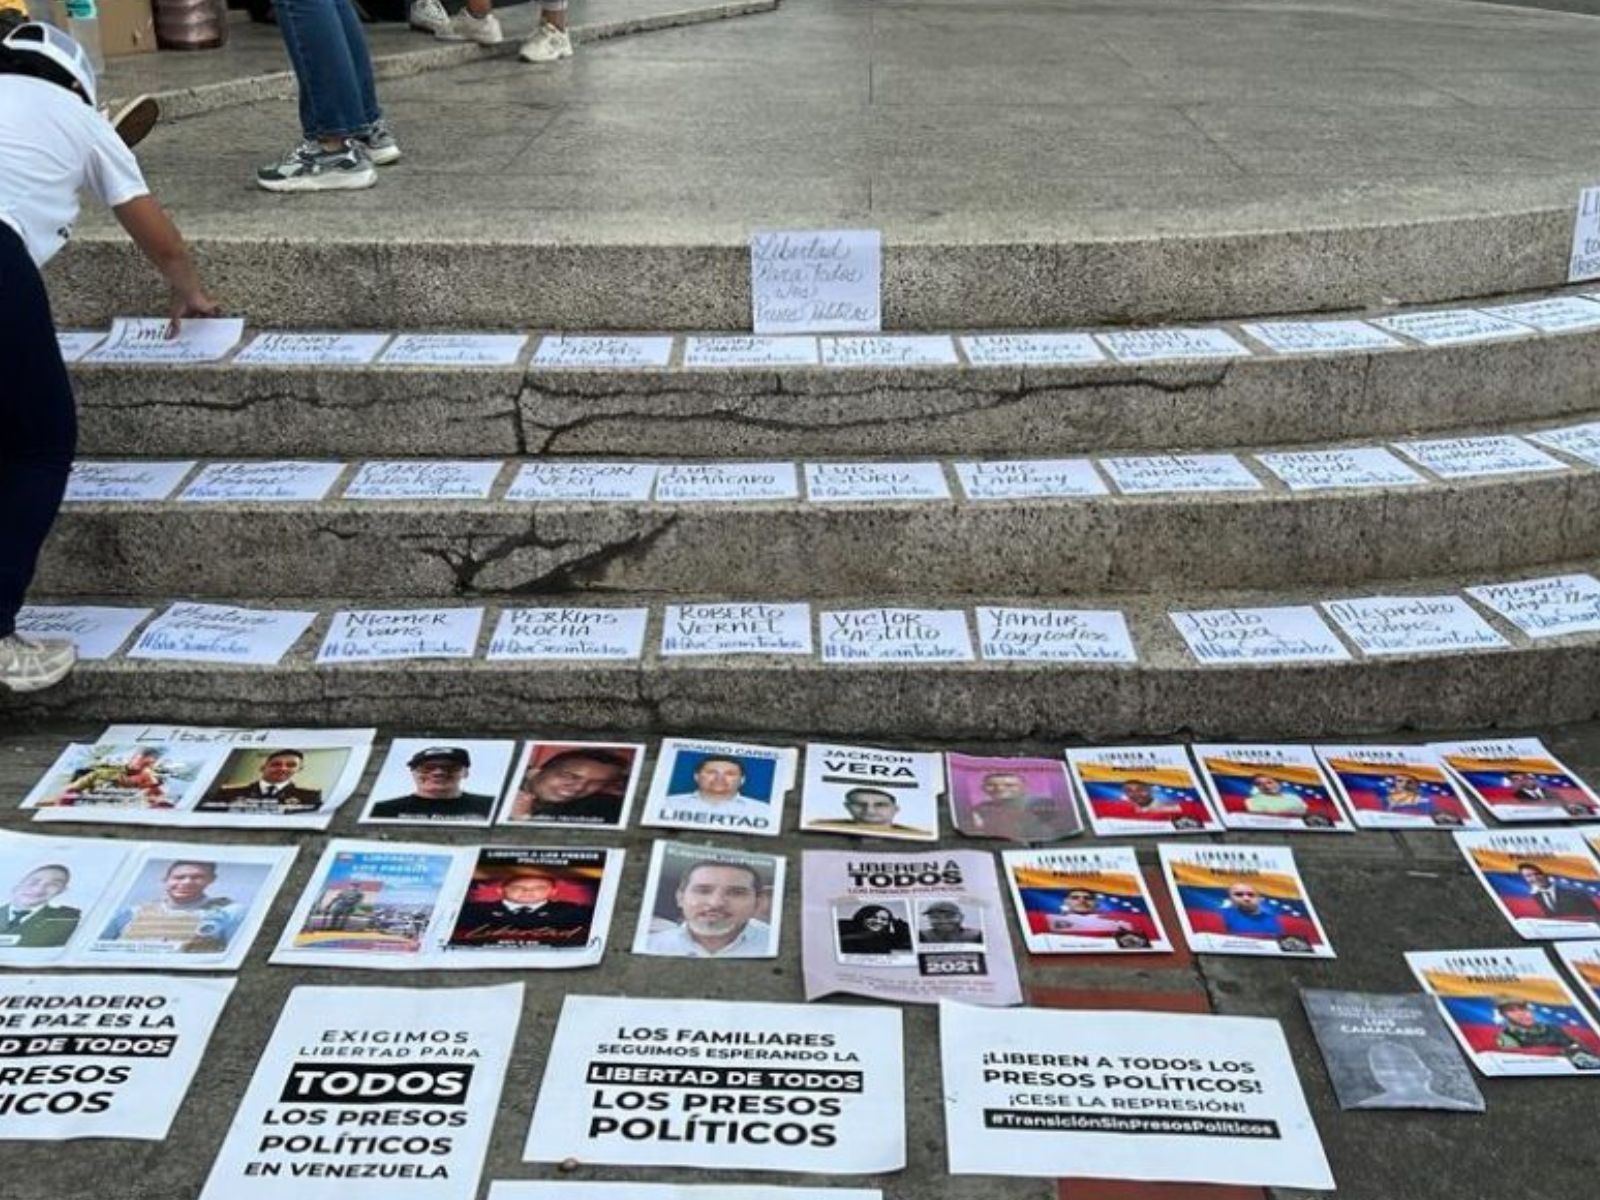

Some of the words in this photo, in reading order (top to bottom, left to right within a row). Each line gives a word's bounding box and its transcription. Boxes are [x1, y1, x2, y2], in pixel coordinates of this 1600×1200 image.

[822, 749, 914, 764] JACKSON
[824, 760, 916, 778] VERA
[659, 809, 770, 829] LIBERTAD
[848, 862, 938, 873] LIBEREN
[945, 859, 960, 870] A
[848, 871, 964, 888] TODOS
[926, 961, 980, 974] 2021
[32, 1014, 91, 1028] PAZ
[97, 1014, 132, 1028] ES
[139, 1014, 175, 1029] LA
[26, 1038, 70, 1054] DE
[74, 1038, 171, 1054] TODOS
[321, 1029, 470, 1044] EXIGIMOS
[617, 1027, 669, 1042] LOS
[676, 1029, 836, 1048] FAMILIARES
[299, 1046, 411, 1058] LIBERTAD
[420, 1046, 484, 1059] PARA
[597, 1043, 701, 1058] SEGUIMOS
[706, 1047, 829, 1062] ESPERANDO
[834, 1051, 860, 1063] LA
[983, 1051, 1090, 1068] ¡LIBEREN
[1096, 1056, 1116, 1069] A
[1122, 1057, 1203, 1071] TODOS
[1210, 1060, 1256, 1075] LOS
[294, 1070, 466, 1097] TODOS
[590, 1066, 719, 1086] LIBERTAD
[727, 1070, 763, 1087] DE
[769, 1073, 861, 1090] TODOS
[983, 1069, 1096, 1088] PRESOS
[1103, 1072, 1264, 1094] POLÍTICOS!
[593, 1089, 670, 1112] LOS
[682, 1093, 843, 1117] PRESOS
[1009, 1093, 1073, 1107] ¡CESE
[1077, 1095, 1106, 1108] LA
[1112, 1096, 1246, 1113] REPRESIÓN!
[262, 1109, 328, 1126] LOS
[336, 1109, 468, 1128] PRESOS
[588, 1114, 838, 1148] POLÍTICOS
[258, 1132, 453, 1156] POLÍTICOS
[244, 1161, 280, 1177] EN
[290, 1162, 449, 1179] VENEZUELA
